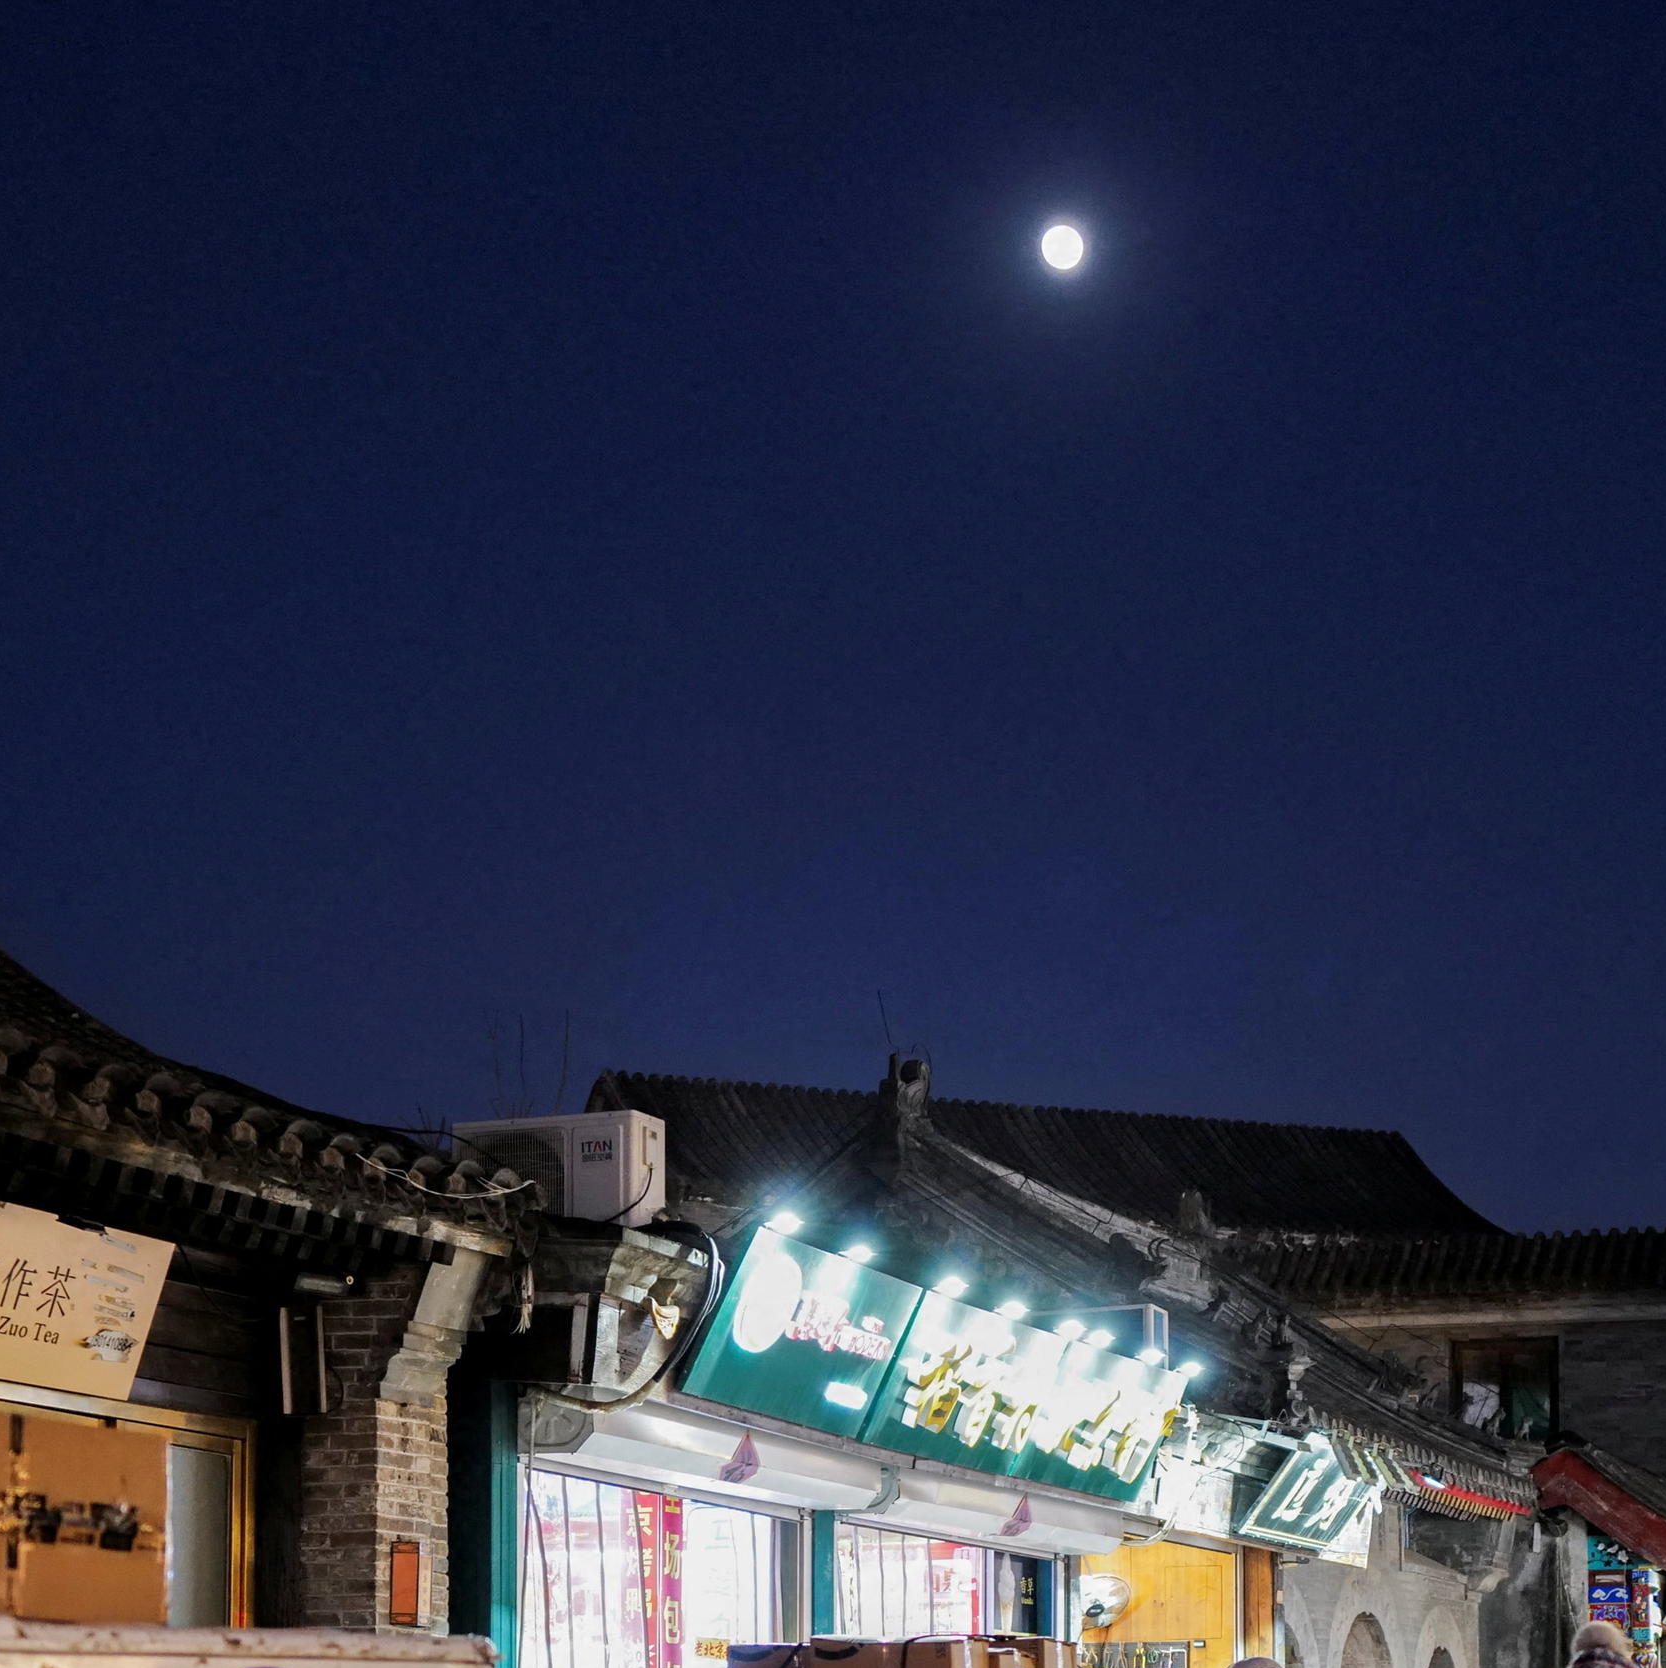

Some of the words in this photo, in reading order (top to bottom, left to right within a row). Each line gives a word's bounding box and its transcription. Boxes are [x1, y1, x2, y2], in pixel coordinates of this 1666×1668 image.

[581, 1138, 613, 1153] ITAN
[32, 1321, 62, 1346] Tea
[694, 1640, 729, 1660] 老北京
